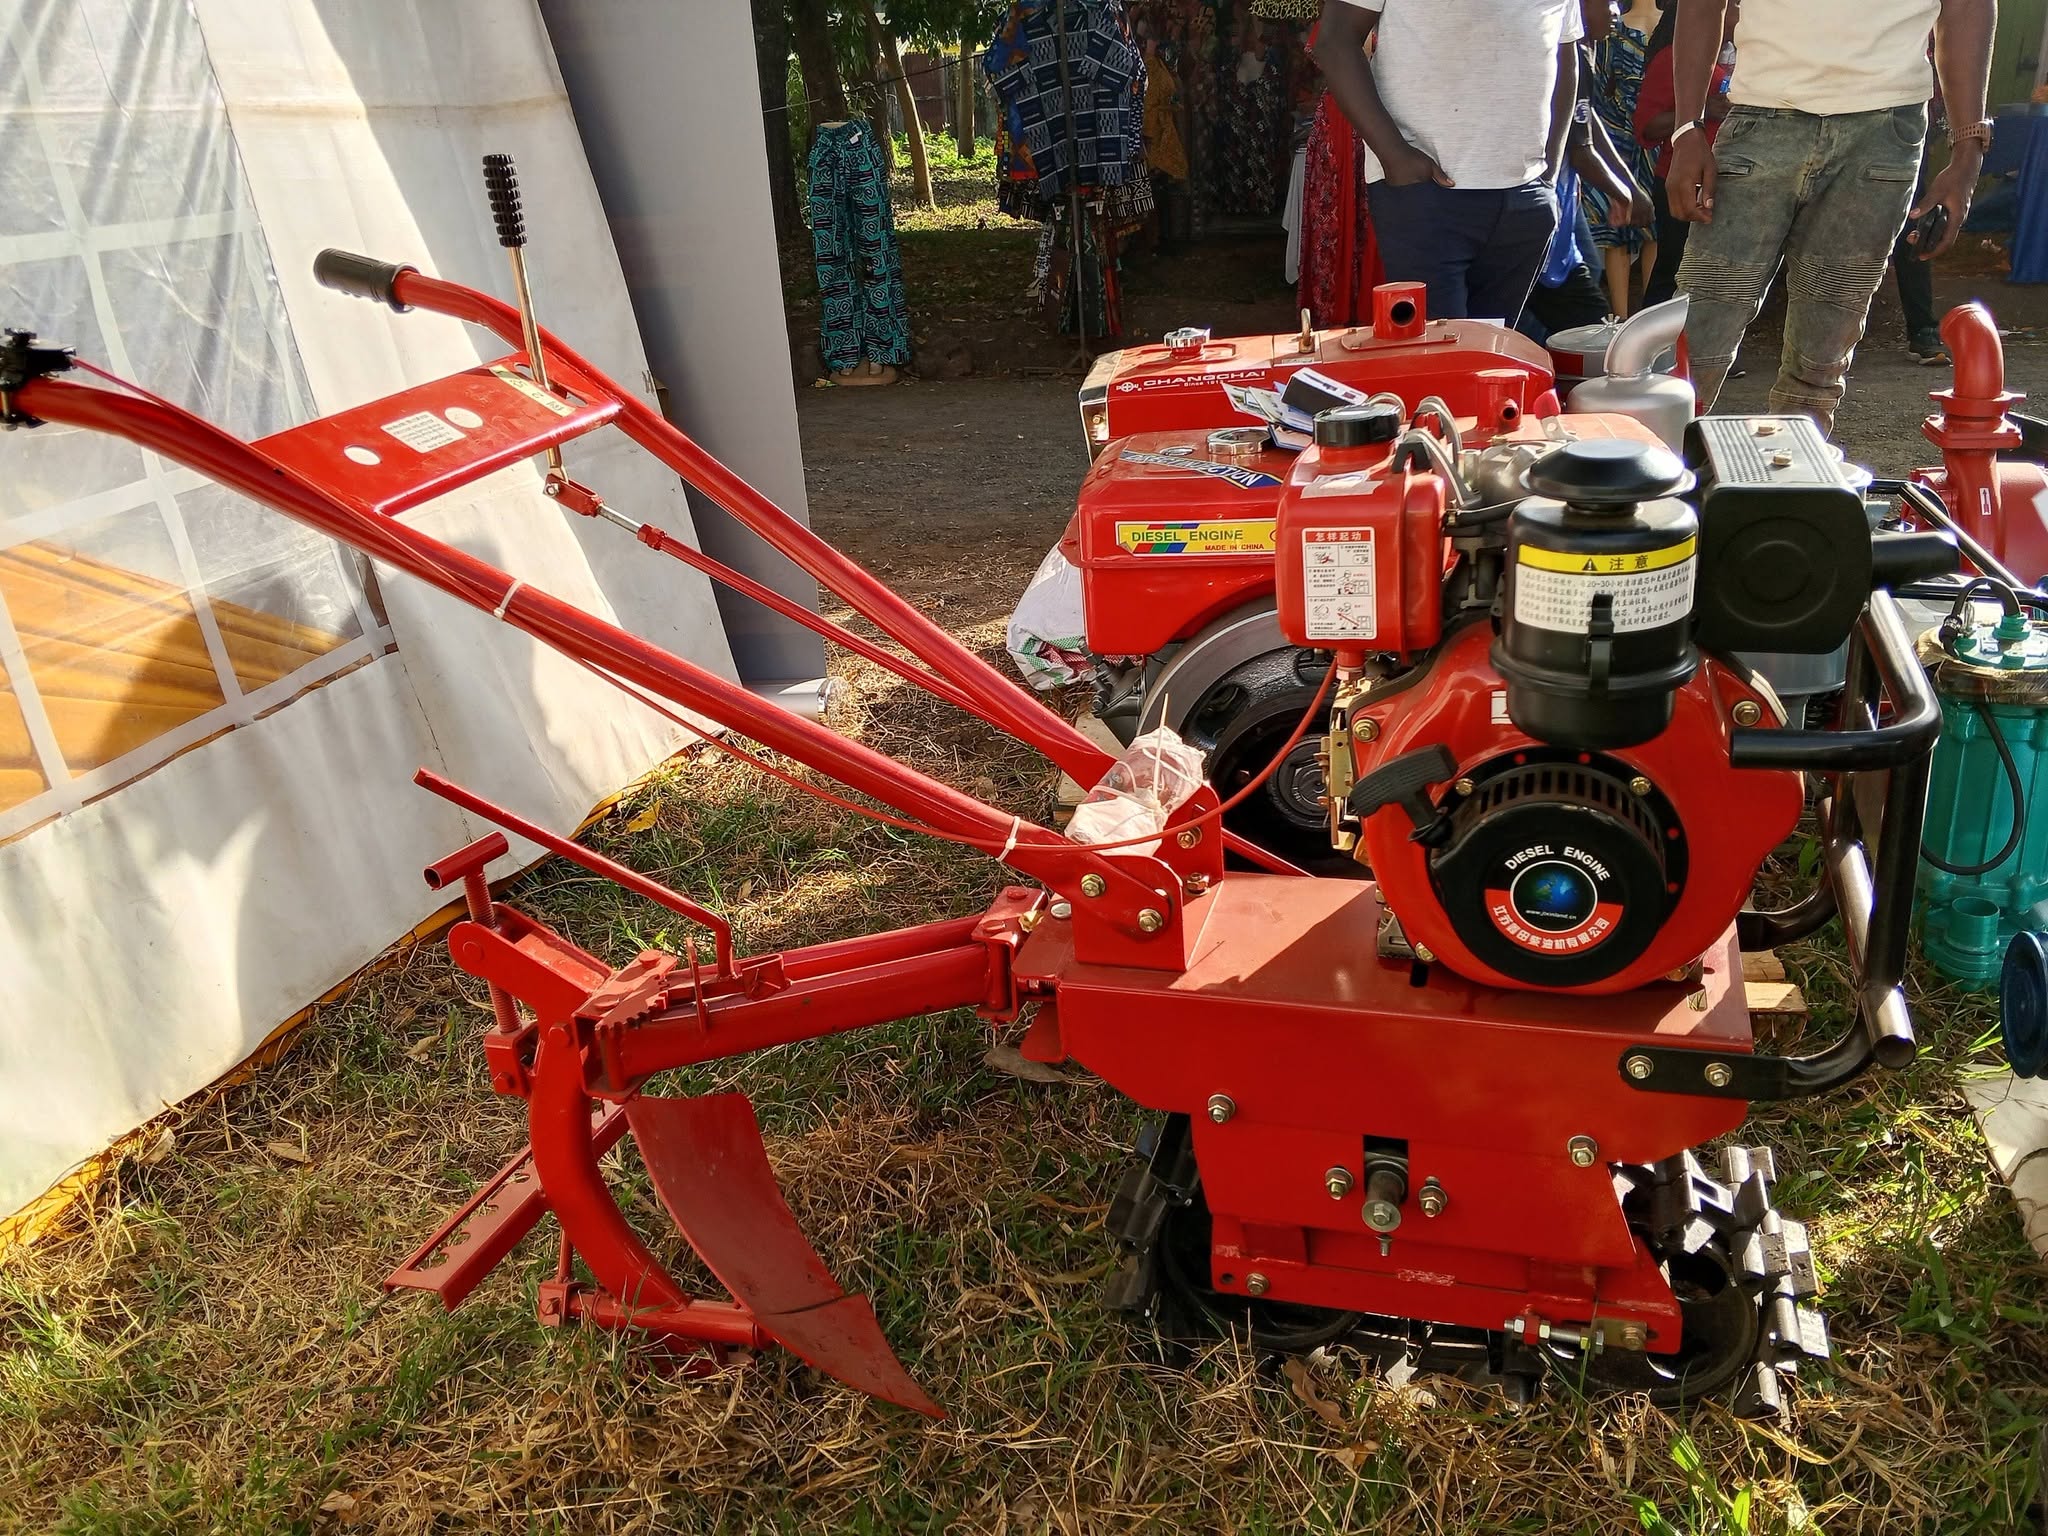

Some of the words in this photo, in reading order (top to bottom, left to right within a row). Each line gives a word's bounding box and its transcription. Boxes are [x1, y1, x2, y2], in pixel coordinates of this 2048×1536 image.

[1143, 371, 1266, 387] CHANGCHAI
[1131, 531, 1182, 542] DIESEL
[1189, 529, 1244, 541] ENGINE
[1315, 531, 1362, 542] 怎样起动
[1609, 554, 1649, 571] 注意
[1504, 844, 1555, 870] DIESEL
[1563, 846, 1611, 882] ENGINE
